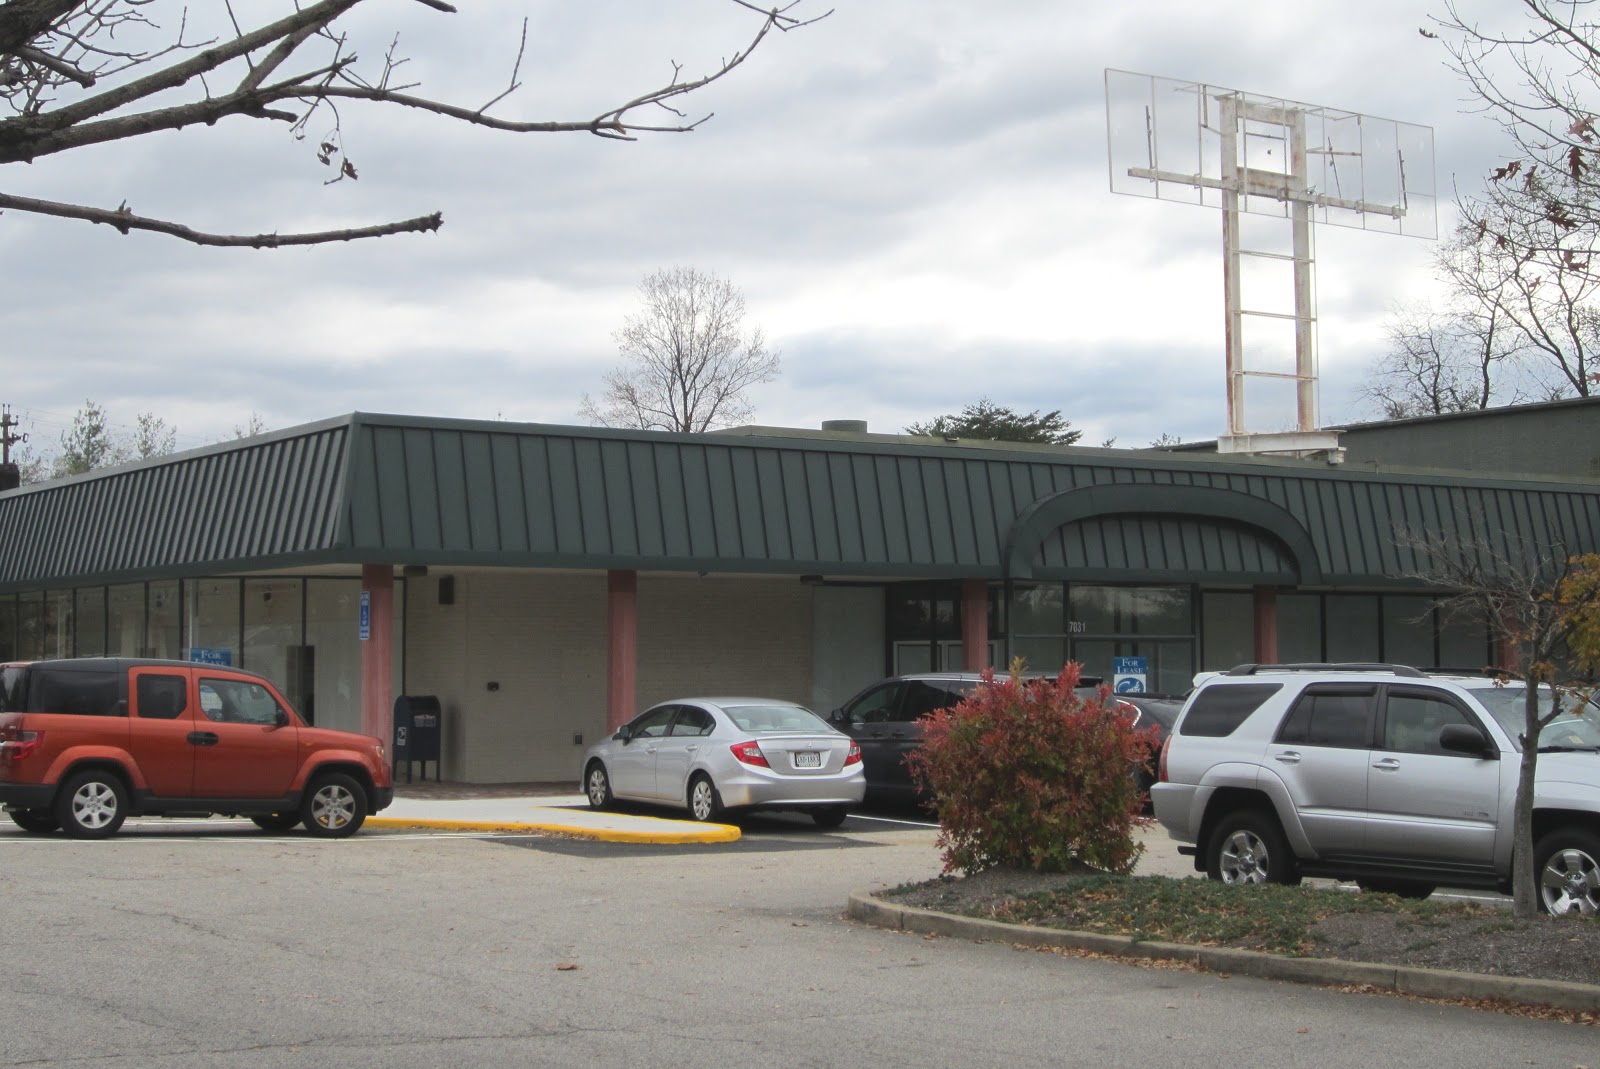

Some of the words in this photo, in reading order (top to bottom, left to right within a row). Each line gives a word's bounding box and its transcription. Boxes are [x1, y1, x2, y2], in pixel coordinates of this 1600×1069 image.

[1069, 621, 1086, 632] 7031
[201, 649, 221, 659] FOR
[1122, 658, 1139, 667] FOR
[1117, 666, 1144, 674] LEASE
